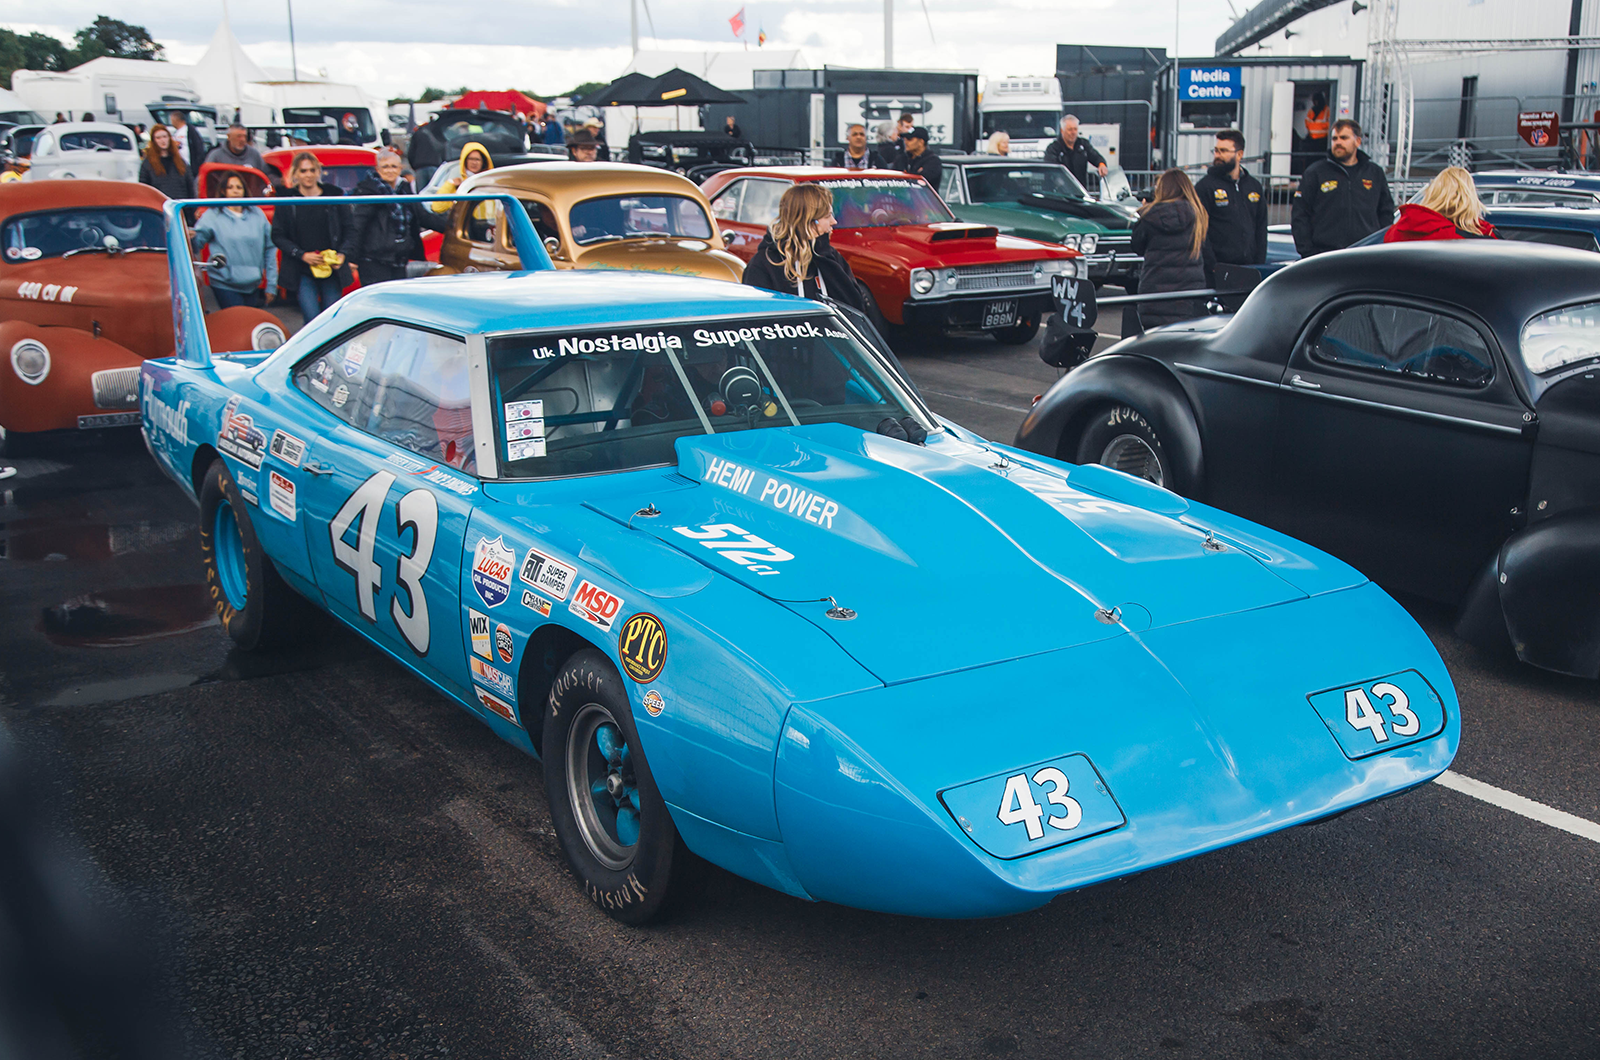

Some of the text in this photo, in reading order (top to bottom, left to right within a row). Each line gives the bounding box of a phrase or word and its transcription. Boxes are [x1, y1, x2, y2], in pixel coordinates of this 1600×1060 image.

[1190, 69, 1230, 82] Media
[1188, 84, 1232, 98] Centre
[17, 281, 42, 299] 440
[1052, 276, 1079, 300] WW
[986, 313, 1013, 326] 888N
[990, 301, 1012, 314] HUV
[1060, 298, 1086, 328] 74
[558, 332, 682, 357] Nostalgia
[693, 321, 823, 348] Superstock
[143, 372, 191, 447] Plymouth
[705, 457, 839, 529] HEMI POWER
[672, 523, 795, 575] 572 CI
[328, 469, 439, 658] 43
[477, 556, 510, 580] LUCAS
[523, 553, 546, 582] ATI
[546, 564, 567, 582] SUPER
[474, 574, 508, 596] OIL PRODUCTS
[540, 573, 566, 593] DAMPER
[574, 582, 619, 618] MSD
[470, 616, 489, 634] WIX
[622, 617, 664, 670] PTC
[481, 662, 514, 690] NASCAR
[550, 668, 603, 717] Hoosier
[1344, 681, 1421, 744] 43
[996, 766, 1083, 842] 43
